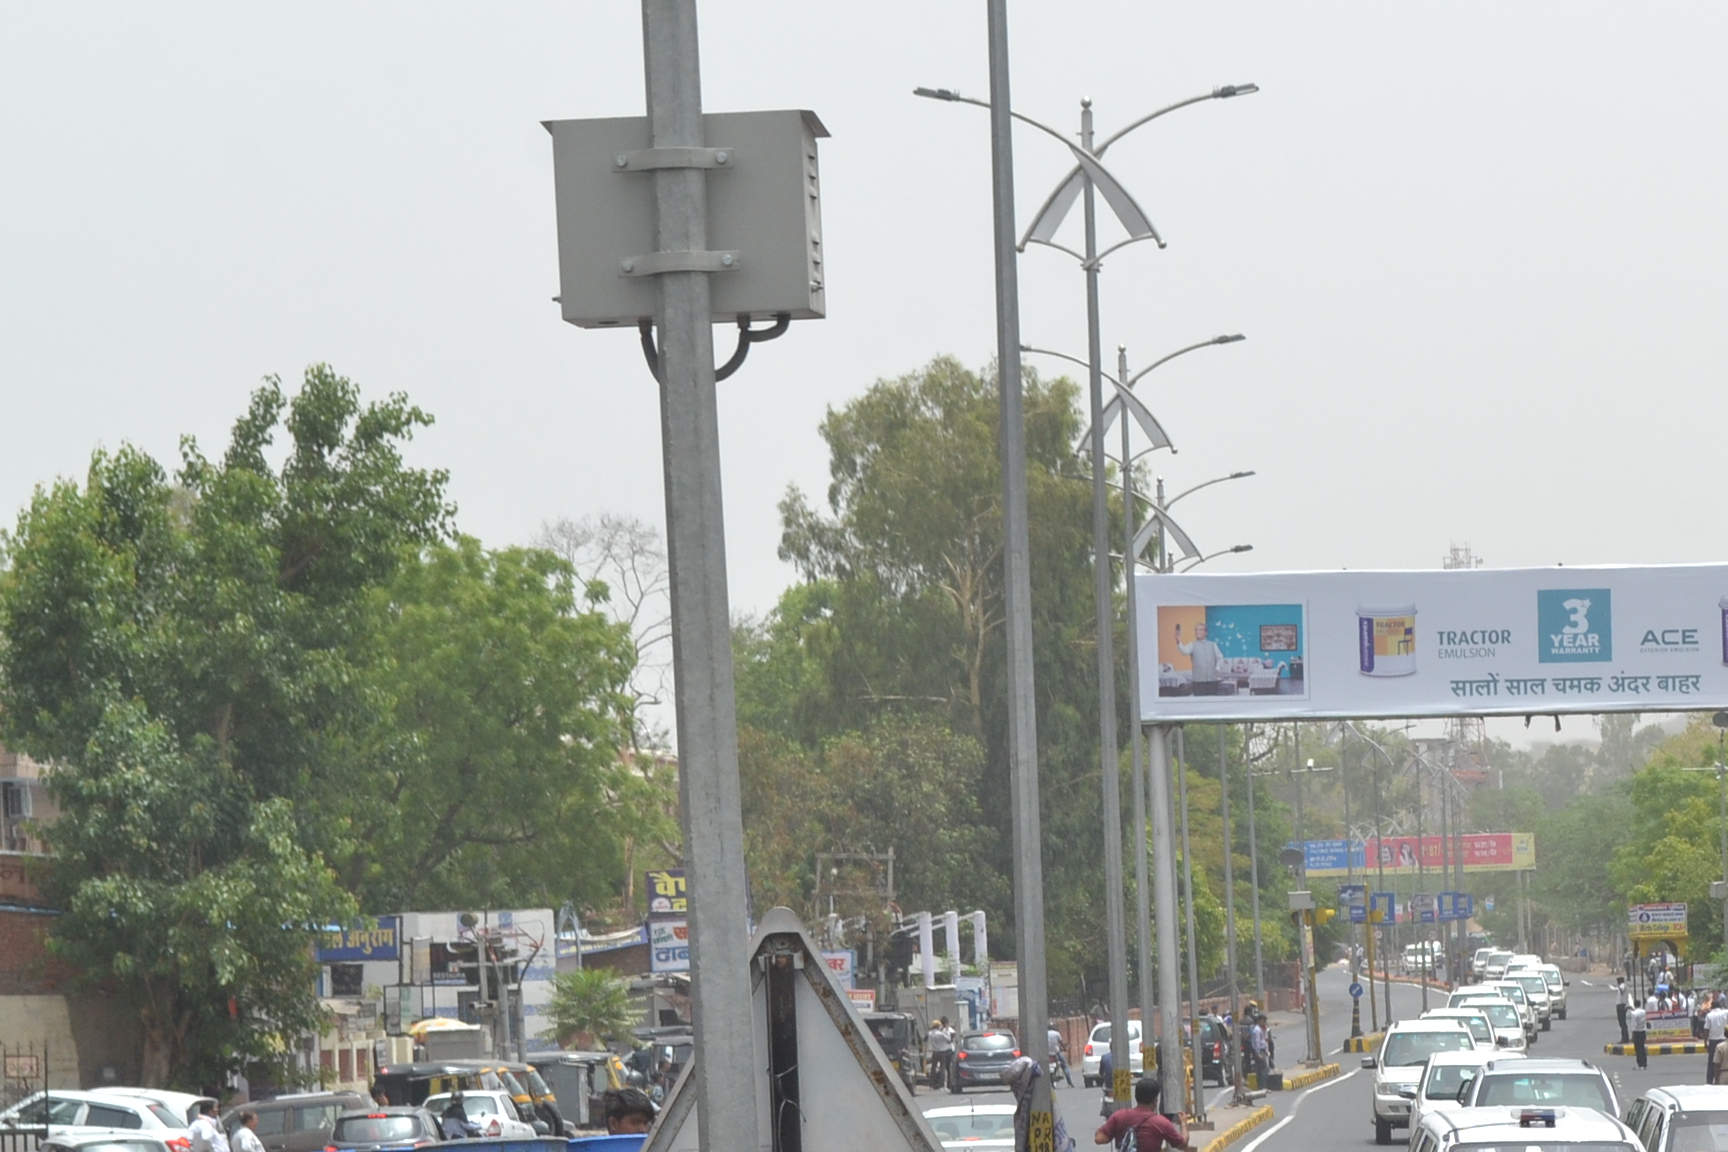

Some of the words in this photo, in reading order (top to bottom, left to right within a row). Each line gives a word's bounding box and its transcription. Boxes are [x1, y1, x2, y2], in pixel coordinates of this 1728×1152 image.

[1562, 598, 1590, 634] 3
[1437, 629, 1512, 646] TRACTOR
[1550, 633, 1600, 648] YEAR
[1640, 629, 1699, 646] ACE
[1438, 648, 1496, 659] EMULSION
[1551, 647, 1600, 655] WARRANTY
[1450, 672, 1499, 697] सालों
[1505, 678, 1547, 696] साल
[1552, 677, 1602, 694] चमक
[1607, 670, 1651, 694] अंदर
[1656, 674, 1702, 694] बाहर
[347, 929, 394, 955] अनुराग
